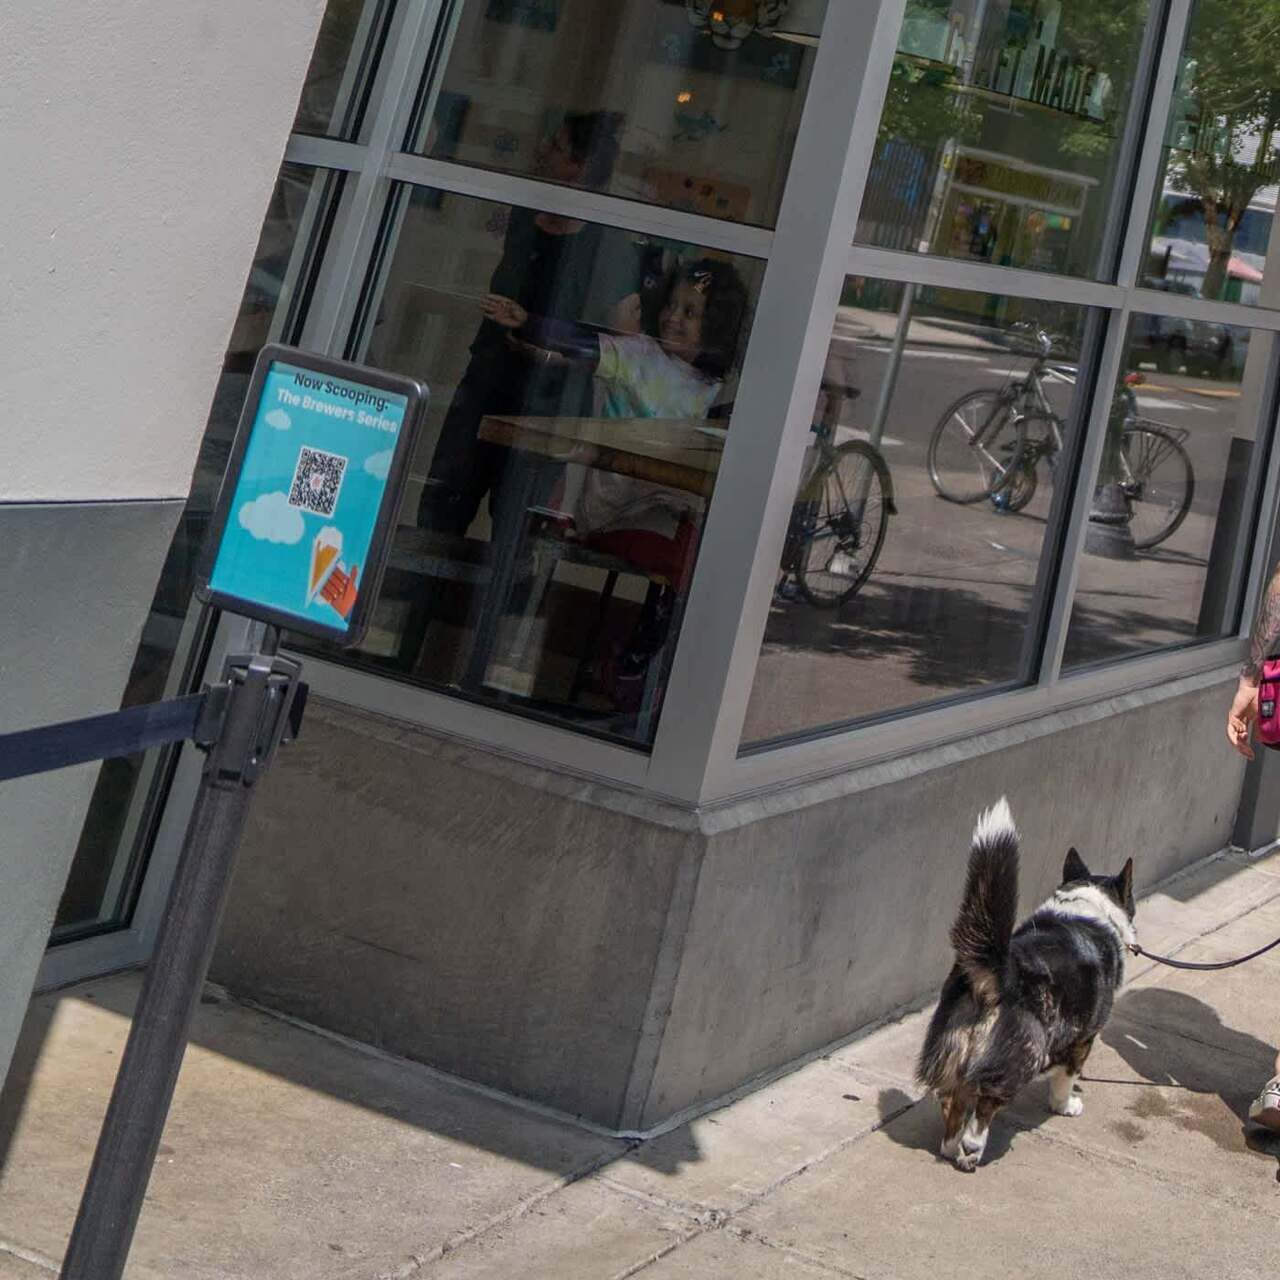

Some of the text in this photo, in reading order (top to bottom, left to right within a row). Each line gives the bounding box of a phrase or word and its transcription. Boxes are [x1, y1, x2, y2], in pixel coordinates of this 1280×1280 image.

[277, 388, 398, 433] The Brewers Series
[294, 372, 389, 412] Now Scooping:
